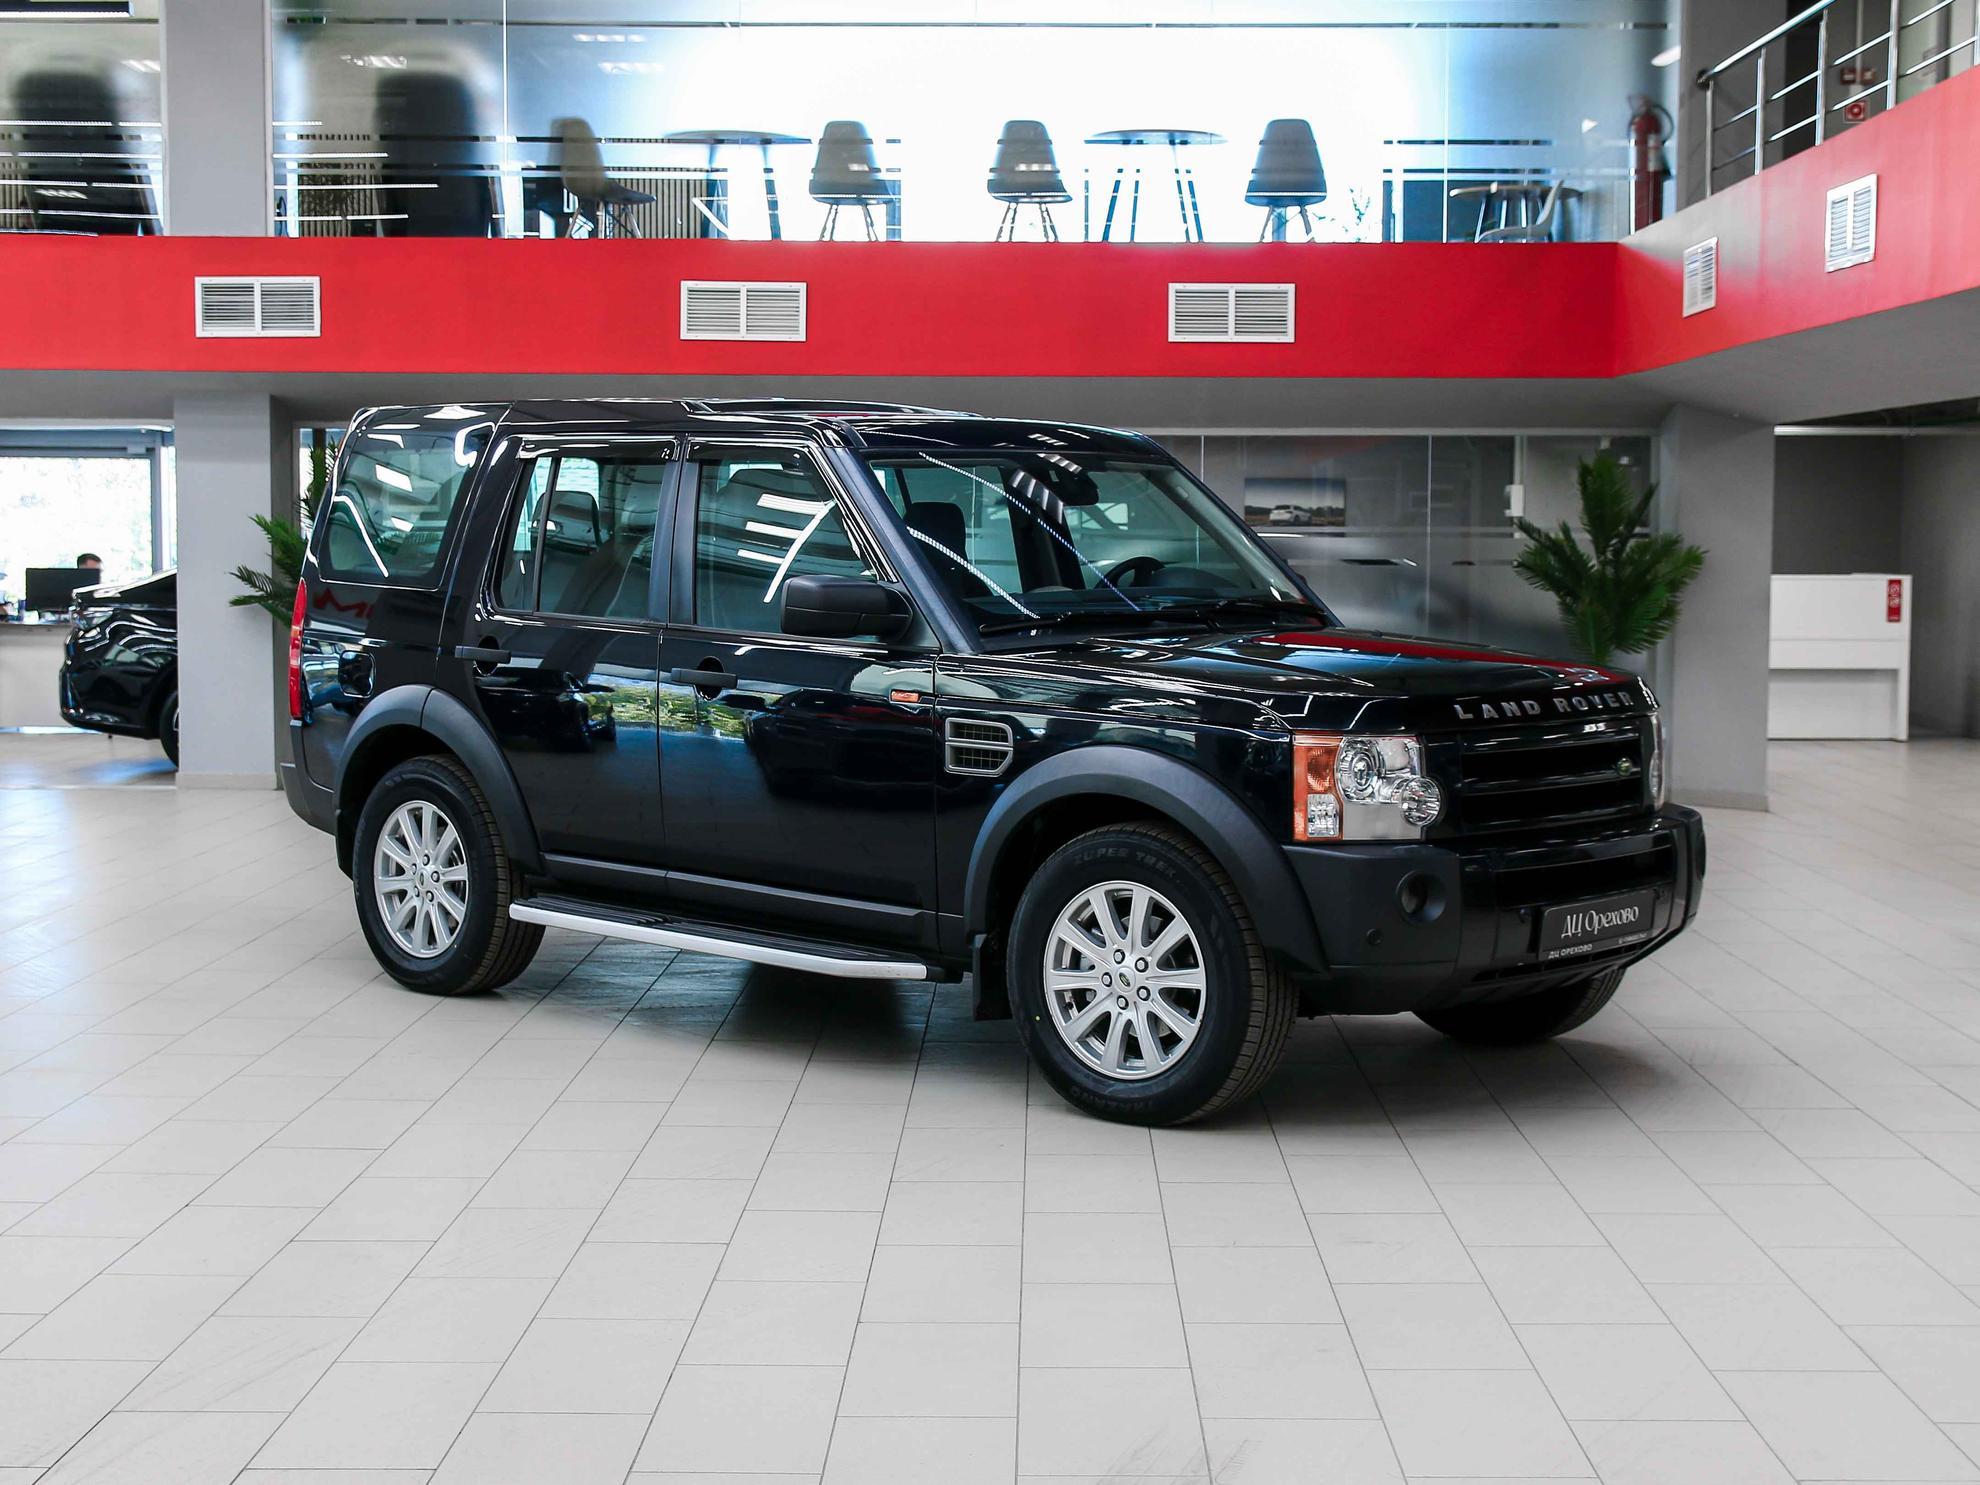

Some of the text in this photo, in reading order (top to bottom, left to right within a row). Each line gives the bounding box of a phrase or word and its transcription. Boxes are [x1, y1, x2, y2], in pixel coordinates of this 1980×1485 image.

[1453, 691, 1635, 719] LAND ROVER
[1561, 906, 1639, 939] ДЦ Орехово
[1561, 943, 1593, 956] ОРЕХОВО
